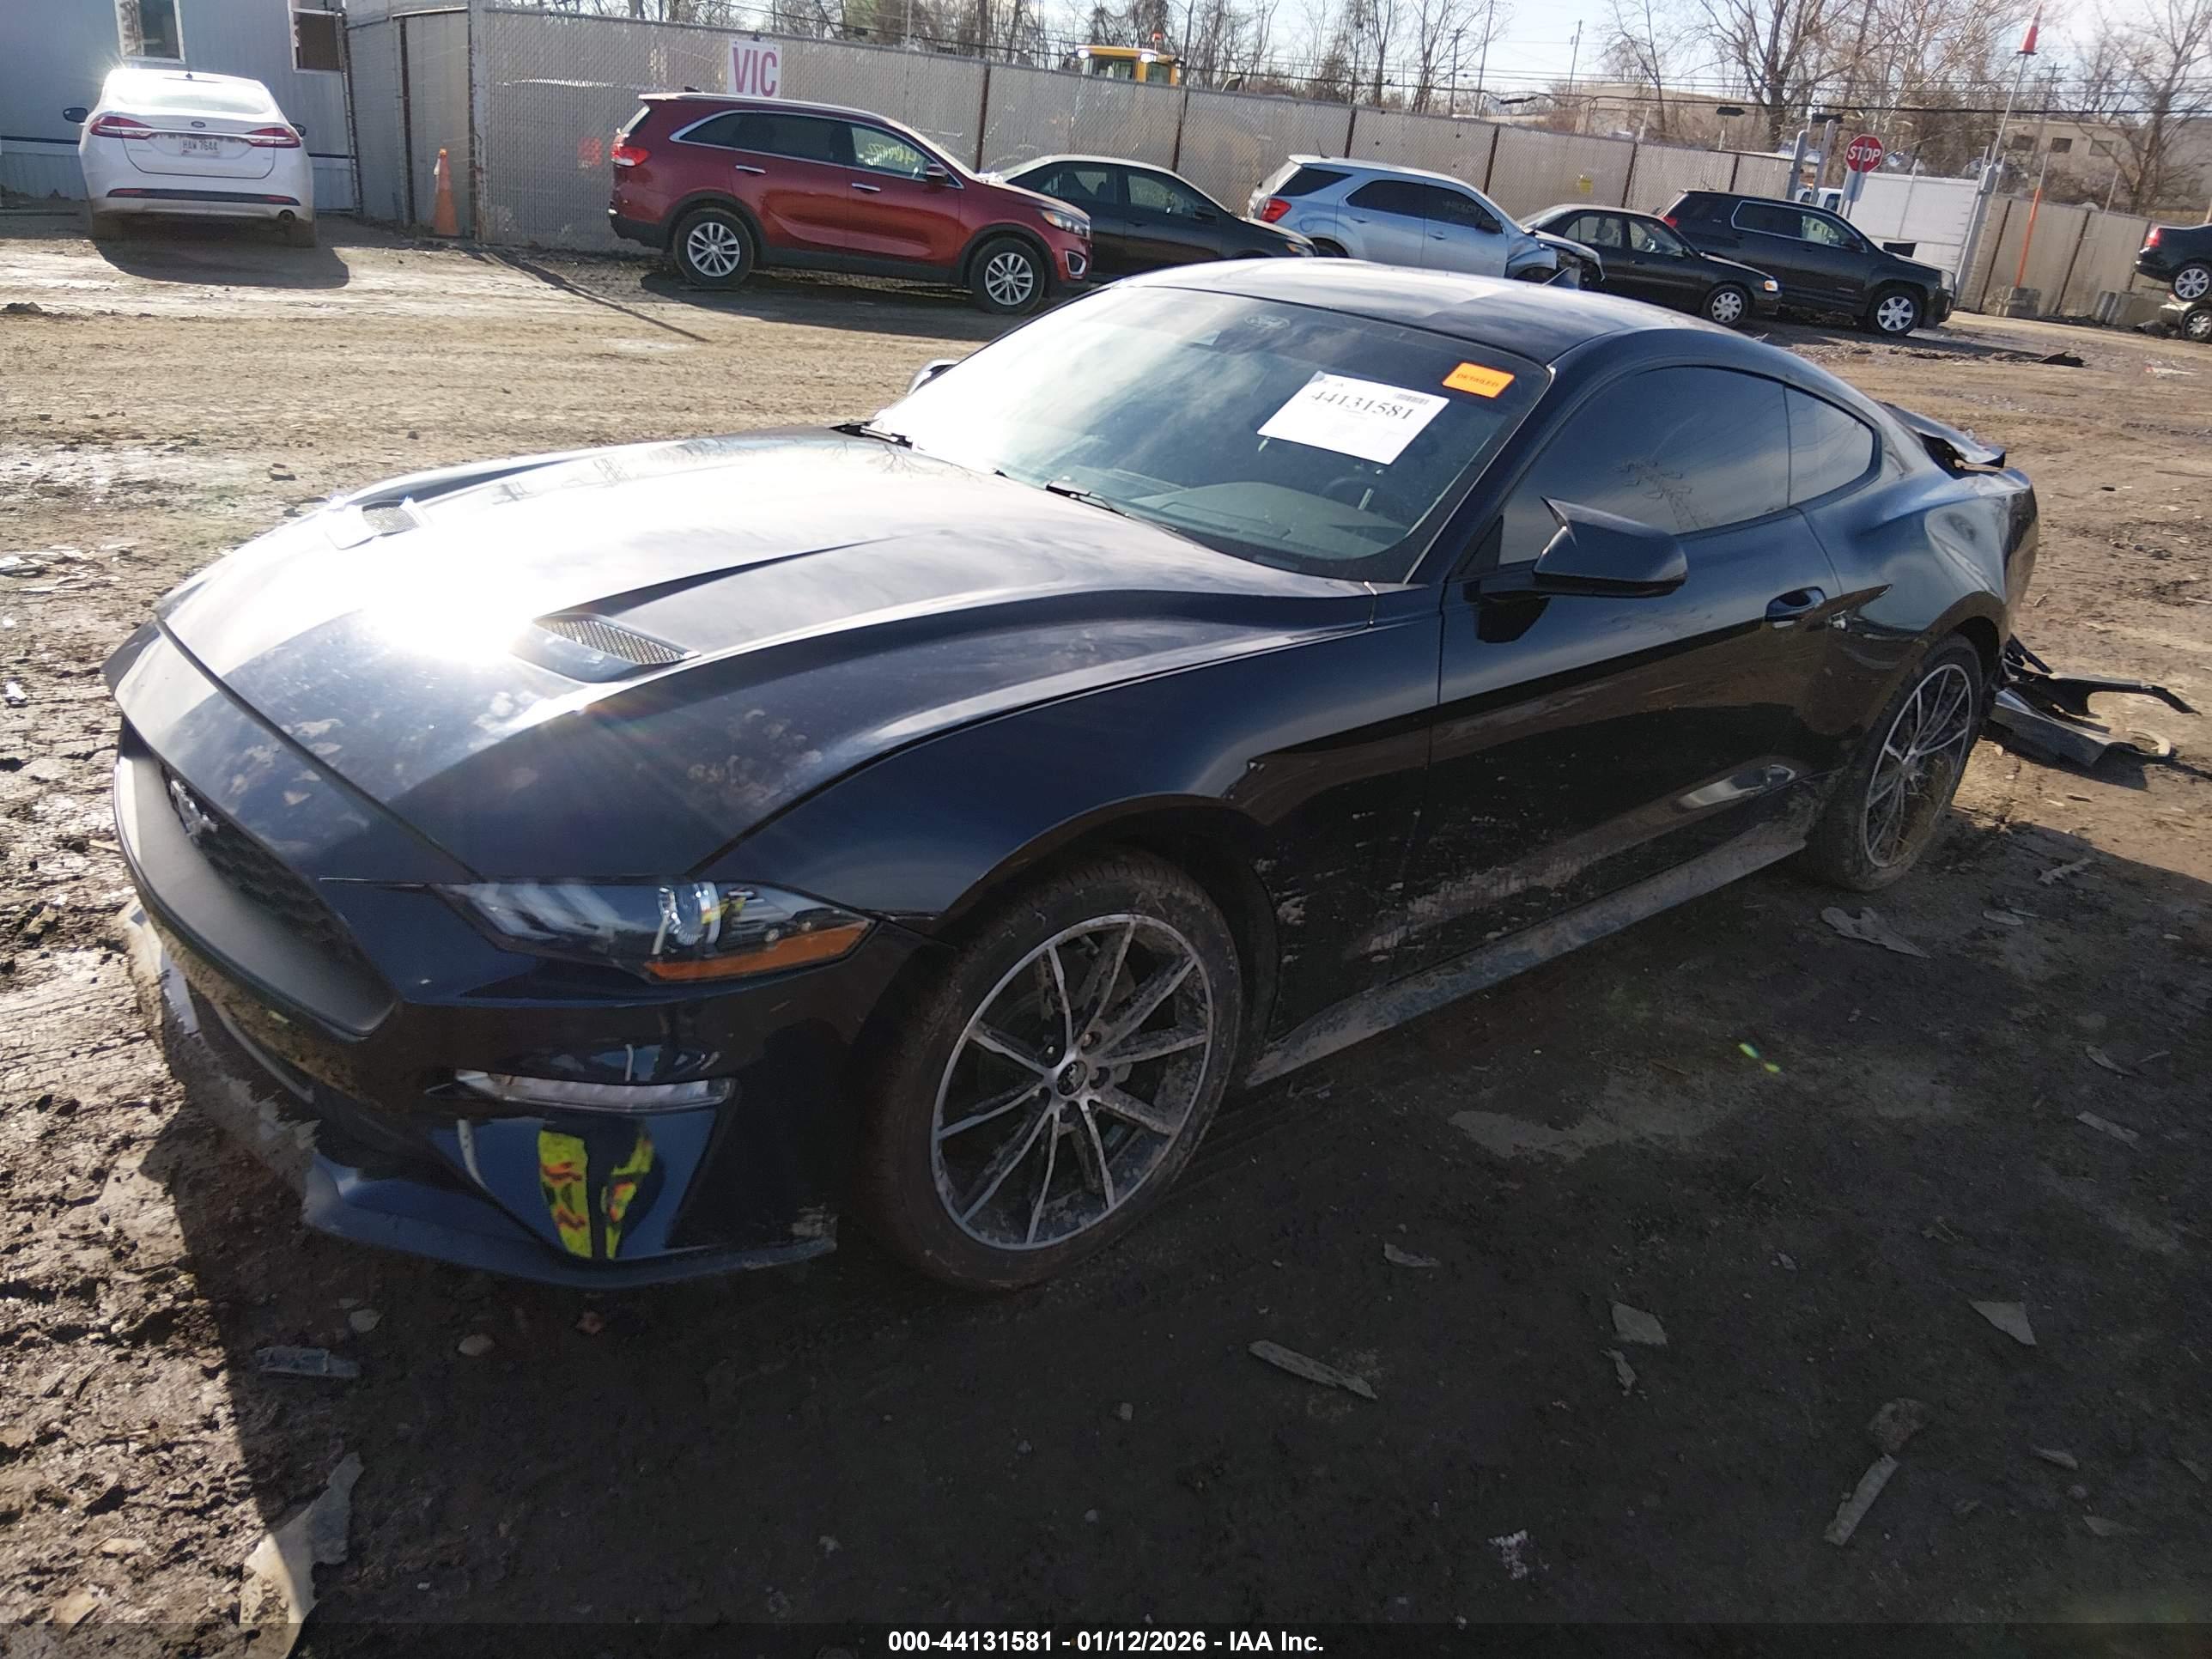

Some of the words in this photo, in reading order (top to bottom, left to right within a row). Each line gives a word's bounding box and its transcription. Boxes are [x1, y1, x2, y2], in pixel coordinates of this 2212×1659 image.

[732, 47, 777, 97] VIC
[1848, 146, 1881, 162] STOP
[1311, 392, 1414, 420] 44131581
